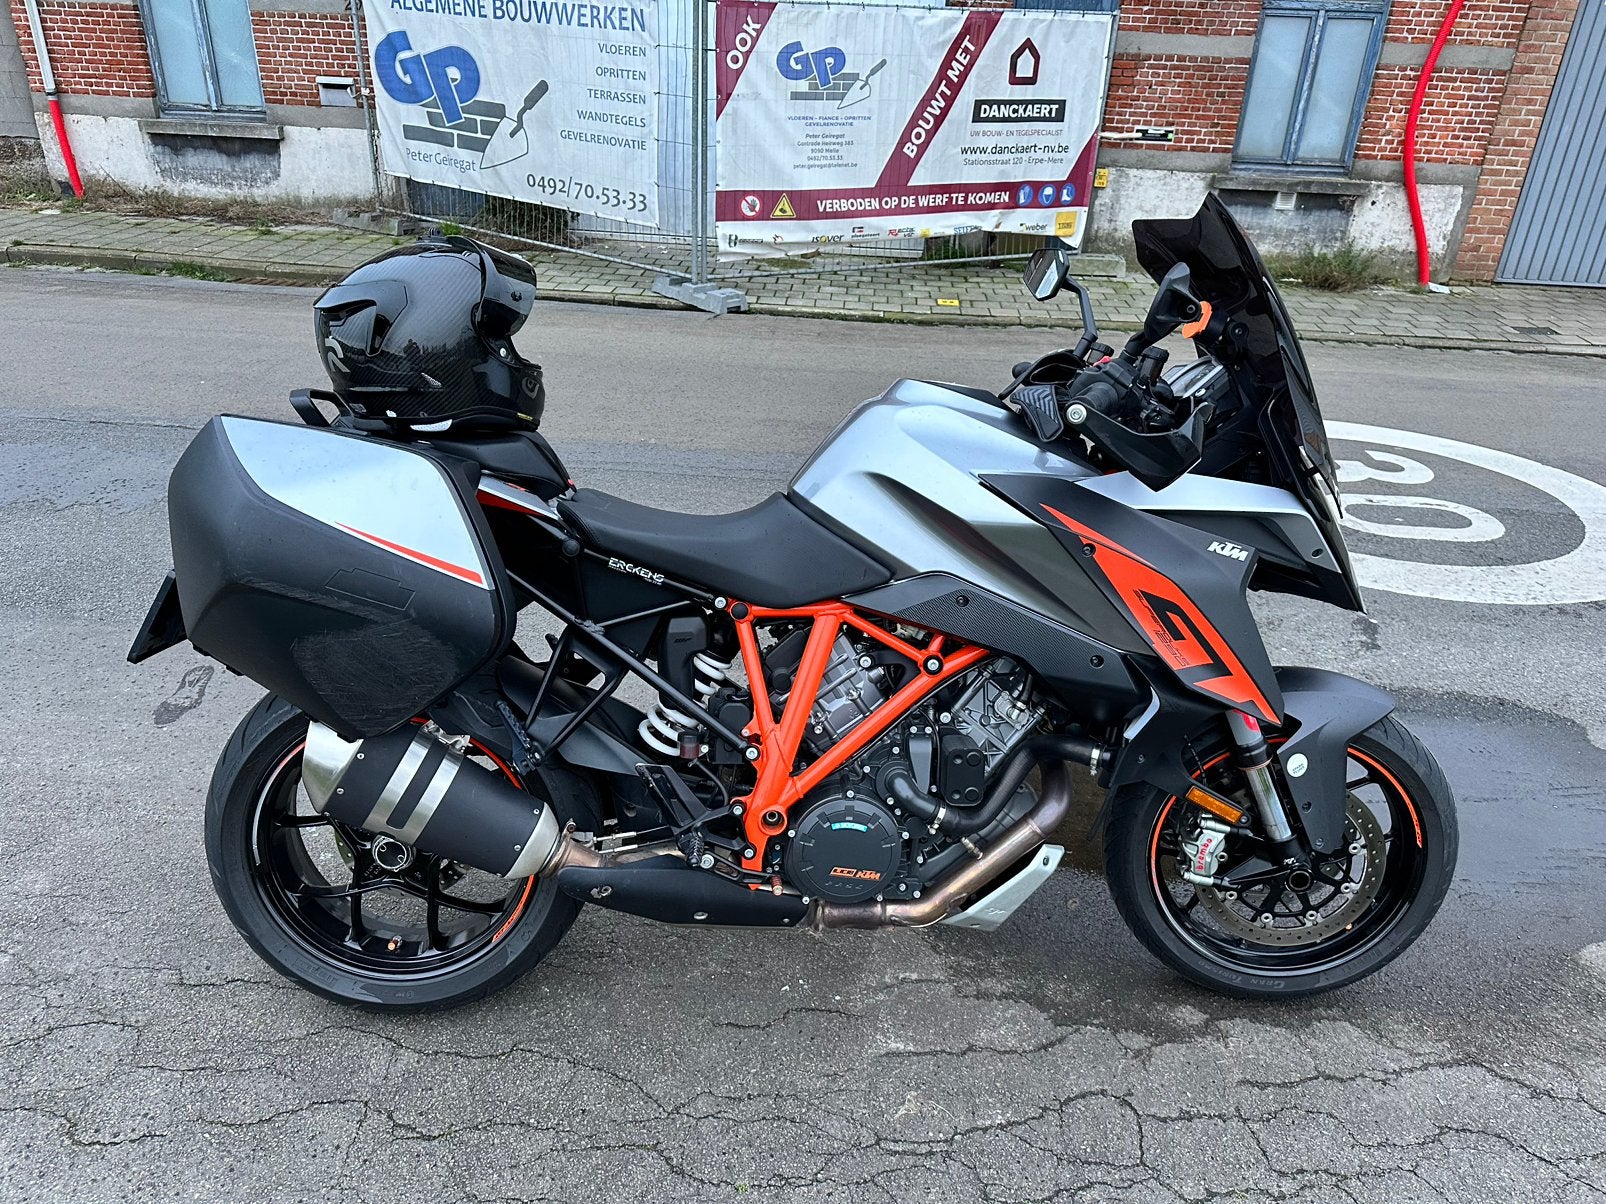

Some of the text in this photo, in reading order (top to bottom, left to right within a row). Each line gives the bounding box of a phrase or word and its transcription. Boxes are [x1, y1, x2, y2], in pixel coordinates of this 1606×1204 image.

[493, 0, 646, 32] BOUWWERKEN
[598, 43, 646, 57] VLOEREN
[726, 14, 762, 70] OOK
[595, 66, 646, 81] OPRITTEN
[776, 40, 847, 89] GP
[375, 30, 480, 125] GP
[587, 88, 646, 104] TERRASSEN
[902, 35, 976, 159] BOUWT MET
[576, 109, 646, 128] WANDTEGELS
[980, 104, 1059, 118] DANCKAERT
[560, 129, 647, 151] GEVELRENOVATIE
[821, 132, 846, 140] Geiregat
[982, 129, 1005, 137] BOUW-
[1006, 129, 1015, 137] EN
[1015, 128, 1064, 137] TEGELSPECIALIST
[960, 142, 1070, 155] www.danckaert-nv.be
[405, 147, 477, 174] Peter Geiregat
[963, 155, 1064, 166] Stationsstraat 120 Erpe-Mere
[526, 173, 648, 212] 0492/70.53.33
[817, 191, 1010, 212] VERBODEN OP DE WERF TE KOMEN
[1025, 222, 1048, 231] weber
[1206, 541, 1249, 561] KTM
[608, 557, 664, 583] ERCKENS
[1195, 838, 1213, 871] brembo
[855, 869, 881, 881] KTM
